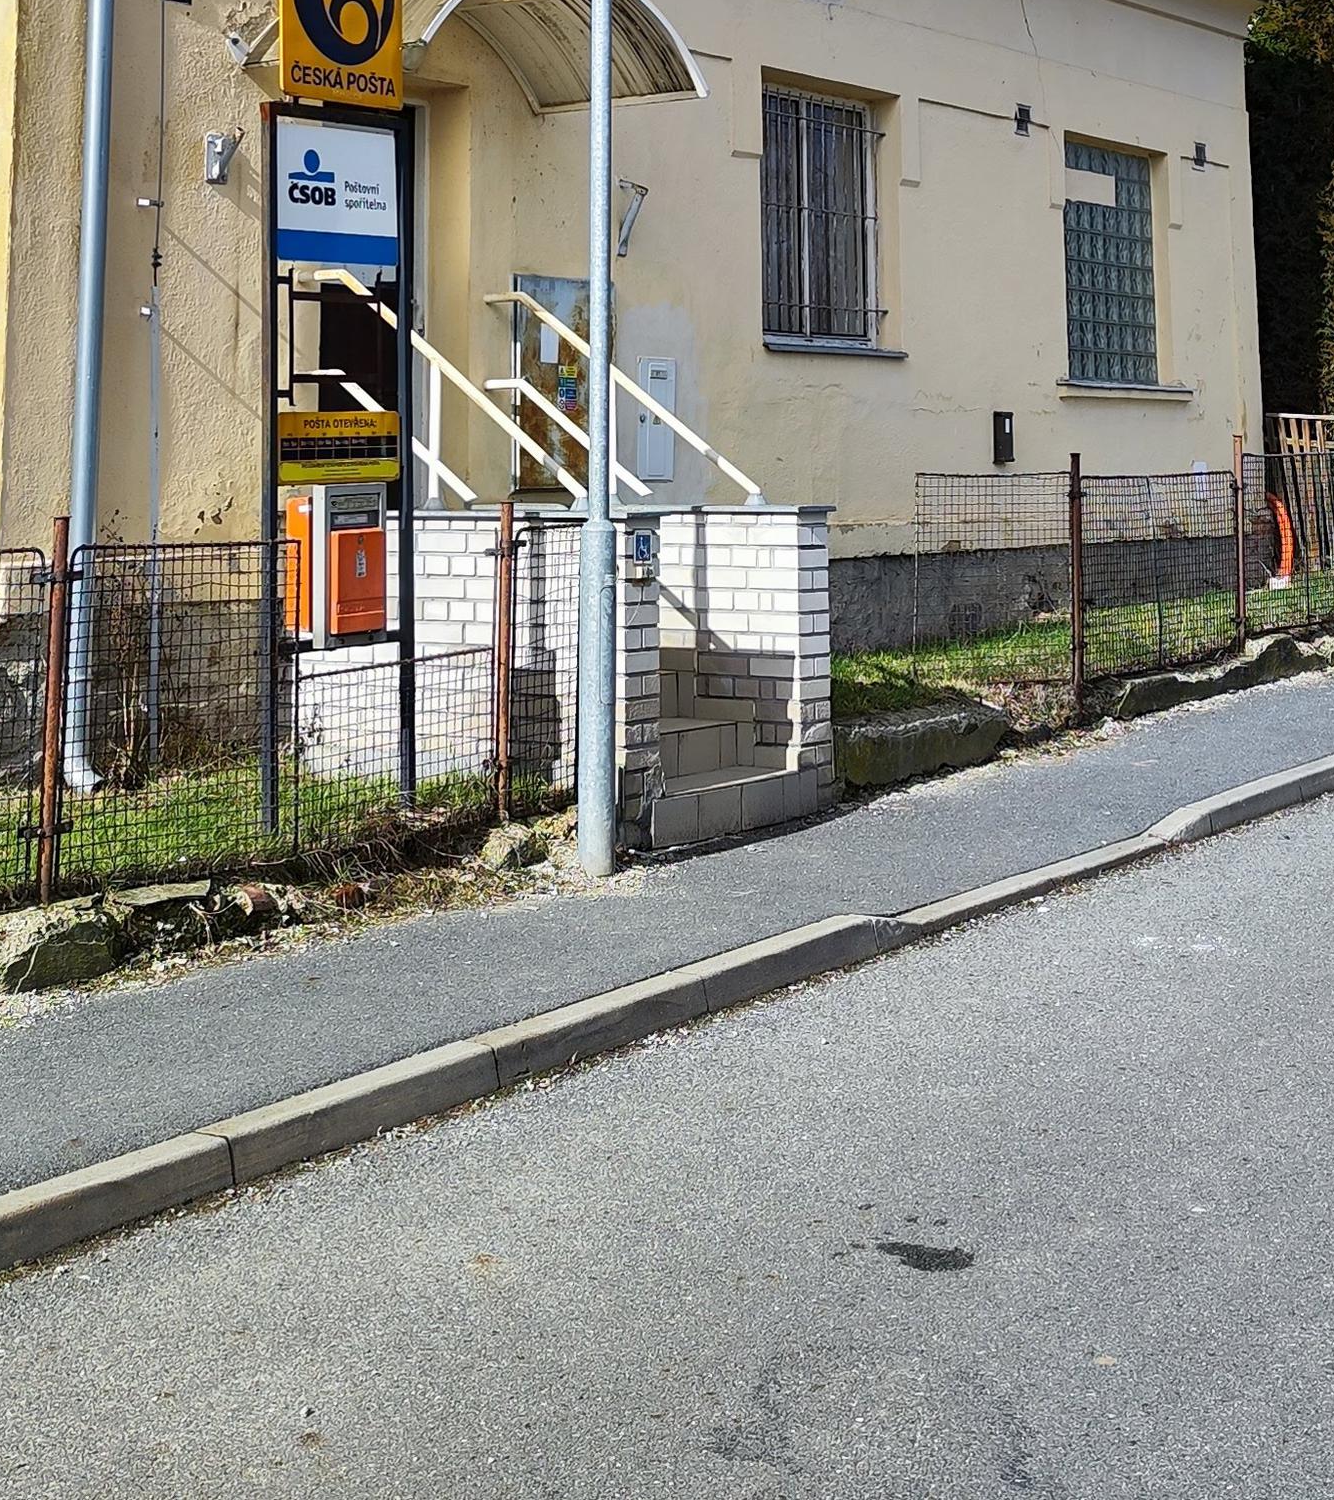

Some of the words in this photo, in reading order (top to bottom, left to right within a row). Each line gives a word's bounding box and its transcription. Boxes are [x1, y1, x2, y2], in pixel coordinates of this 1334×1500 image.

[291, 60, 343, 89] ČESKÁ
[346, 71, 396, 97] POŠTA
[288, 181, 336, 206] ČSOB
[344, 180, 380, 195] Poštovní
[344, 198, 387, 211] spořitelna
[303, 416, 331, 429] POŠTA
